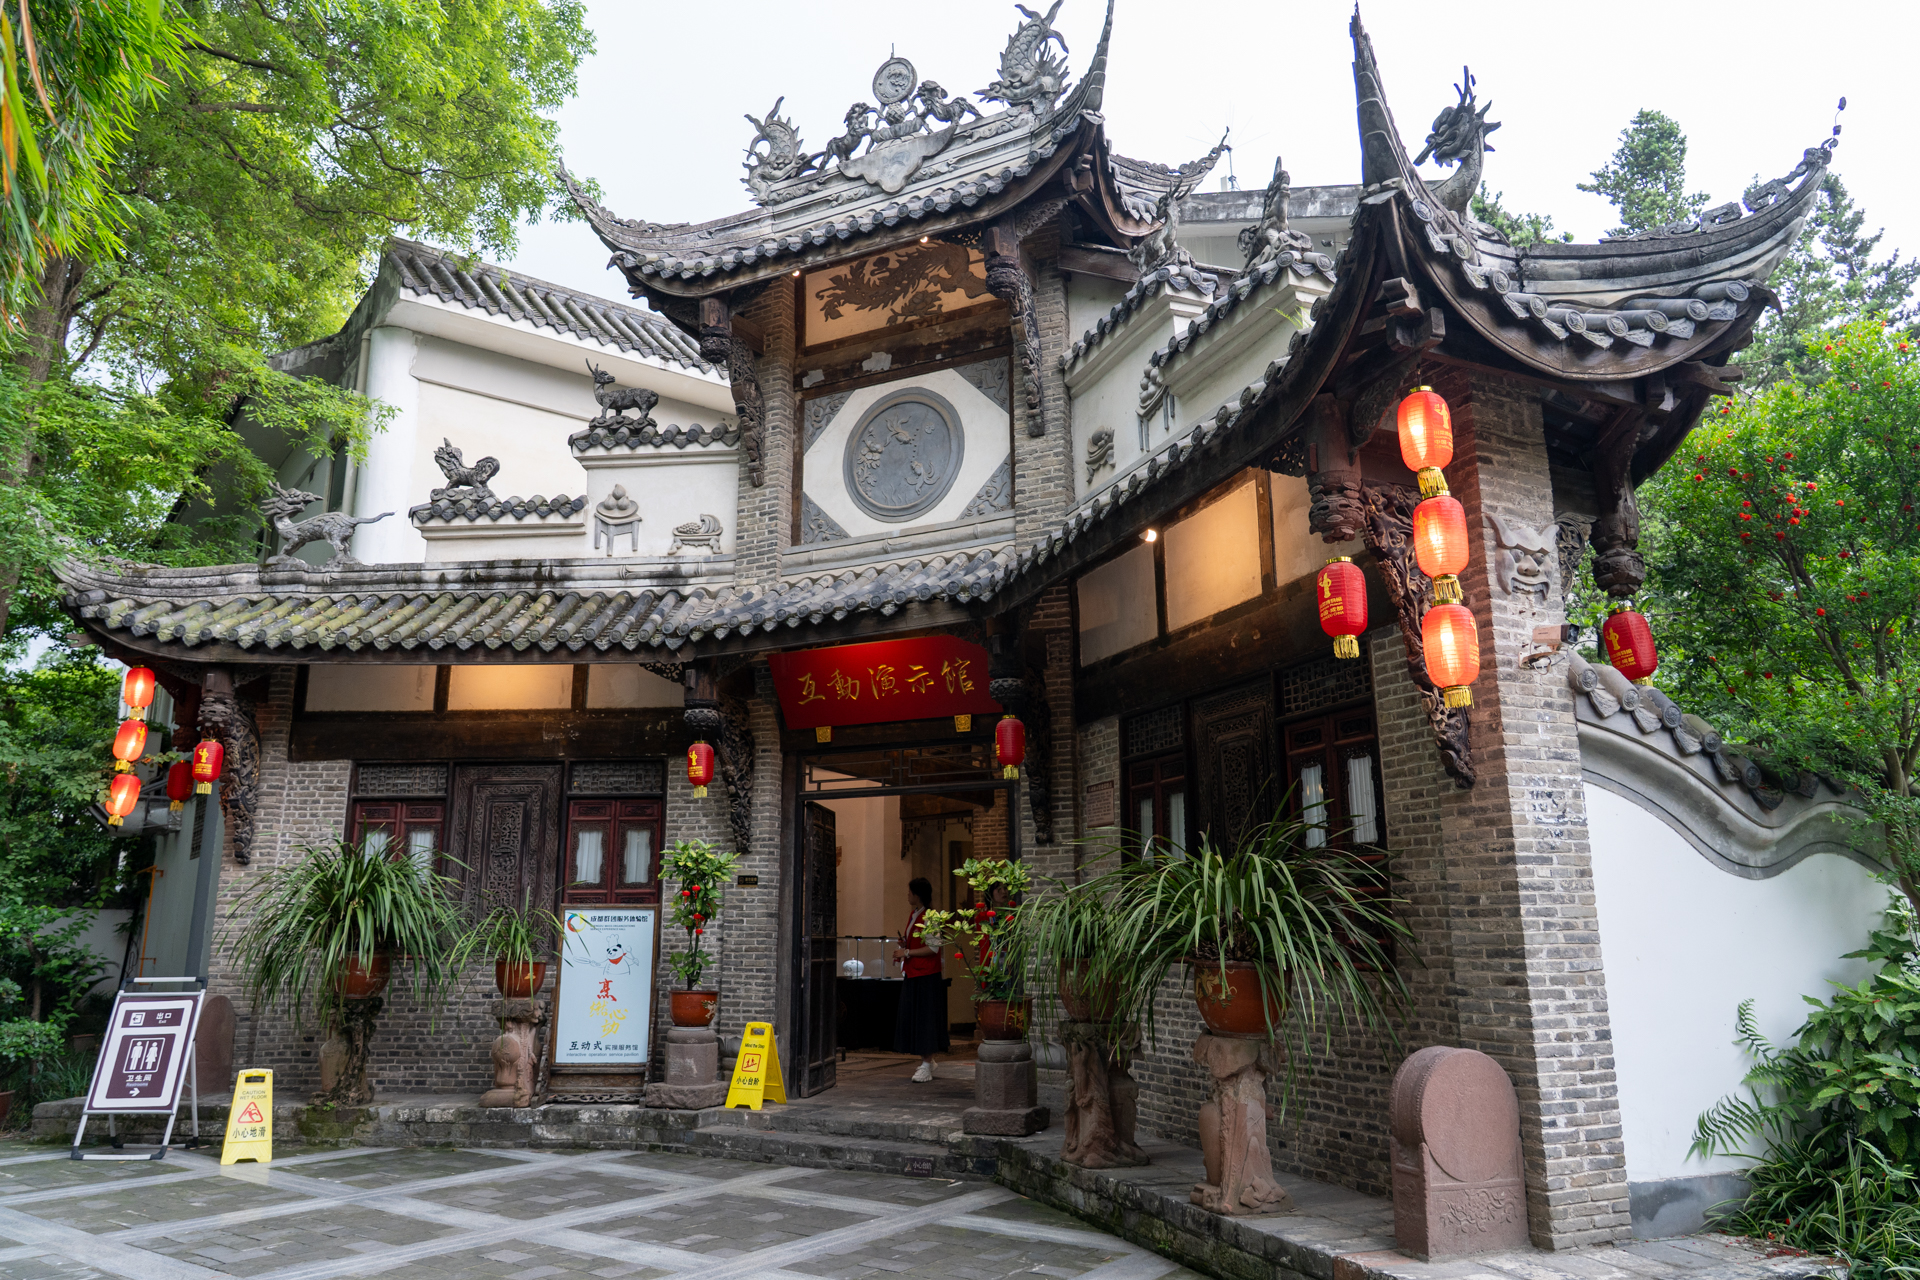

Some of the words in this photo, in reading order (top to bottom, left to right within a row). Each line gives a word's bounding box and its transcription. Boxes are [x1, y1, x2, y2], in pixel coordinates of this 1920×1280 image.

[156, 1012, 172, 1020] 出口
[125, 1074, 152, 1082] 卫生间
[736, 1076, 759, 1086] 小心台阶
[232, 1126, 267, 1139] 小心地滑
